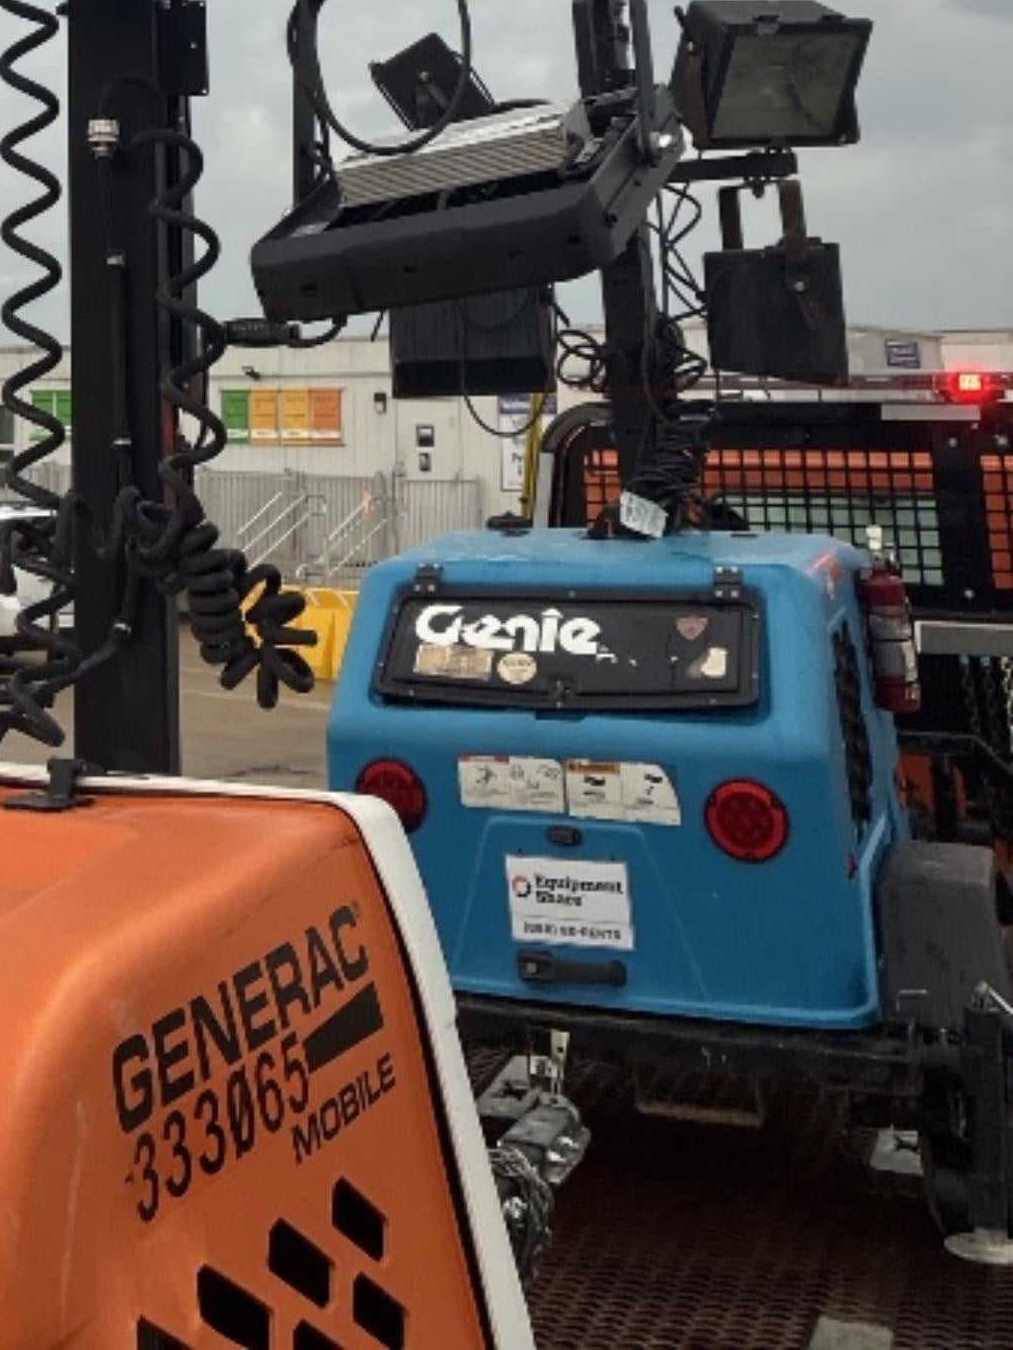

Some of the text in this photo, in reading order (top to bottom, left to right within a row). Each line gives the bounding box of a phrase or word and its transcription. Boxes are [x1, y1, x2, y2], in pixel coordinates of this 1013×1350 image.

[415, 605, 600, 654] Genie
[112, 904, 370, 1134] GENERAC
[132, 1031, 309, 1223] 333065
[291, 1052, 397, 1164] MOBILE
